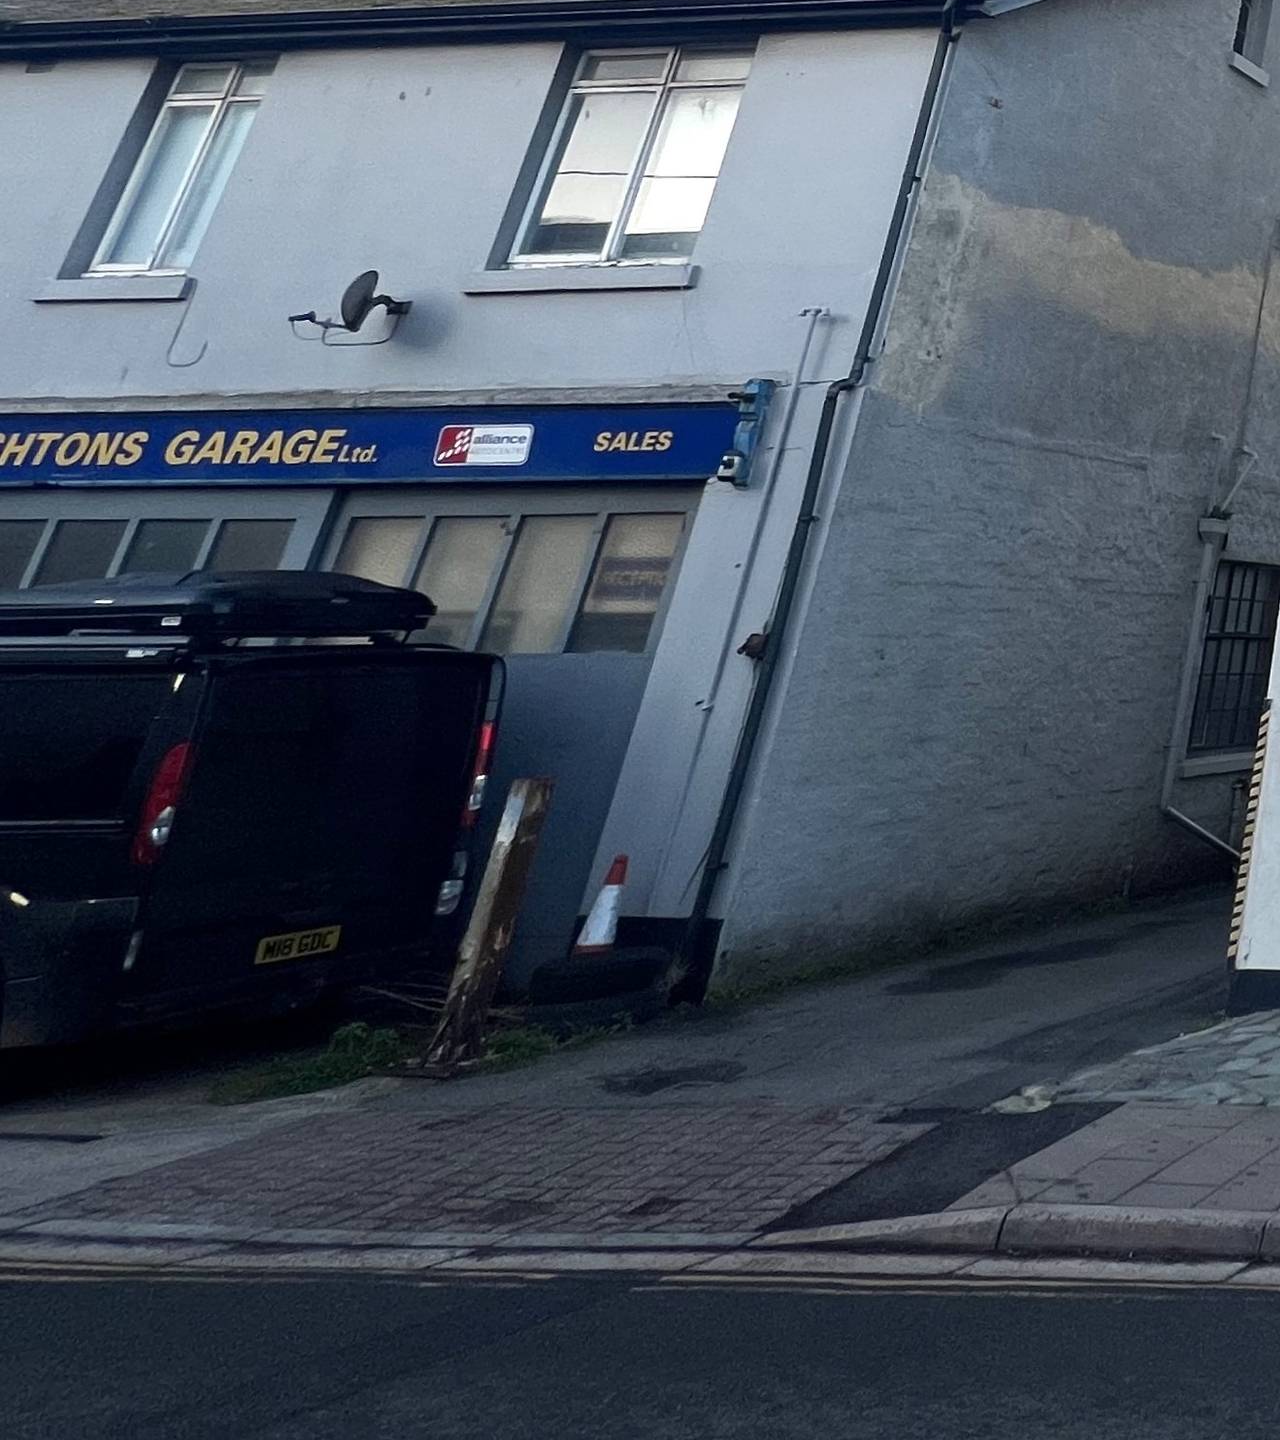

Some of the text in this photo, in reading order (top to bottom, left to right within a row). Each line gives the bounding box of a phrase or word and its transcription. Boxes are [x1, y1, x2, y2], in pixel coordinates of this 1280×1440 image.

[164, 429, 347, 465] GARAGE
[337, 444, 378, 464] Ltd.
[473, 433, 527, 445] alliance
[593, 430, 674, 452] SALES
